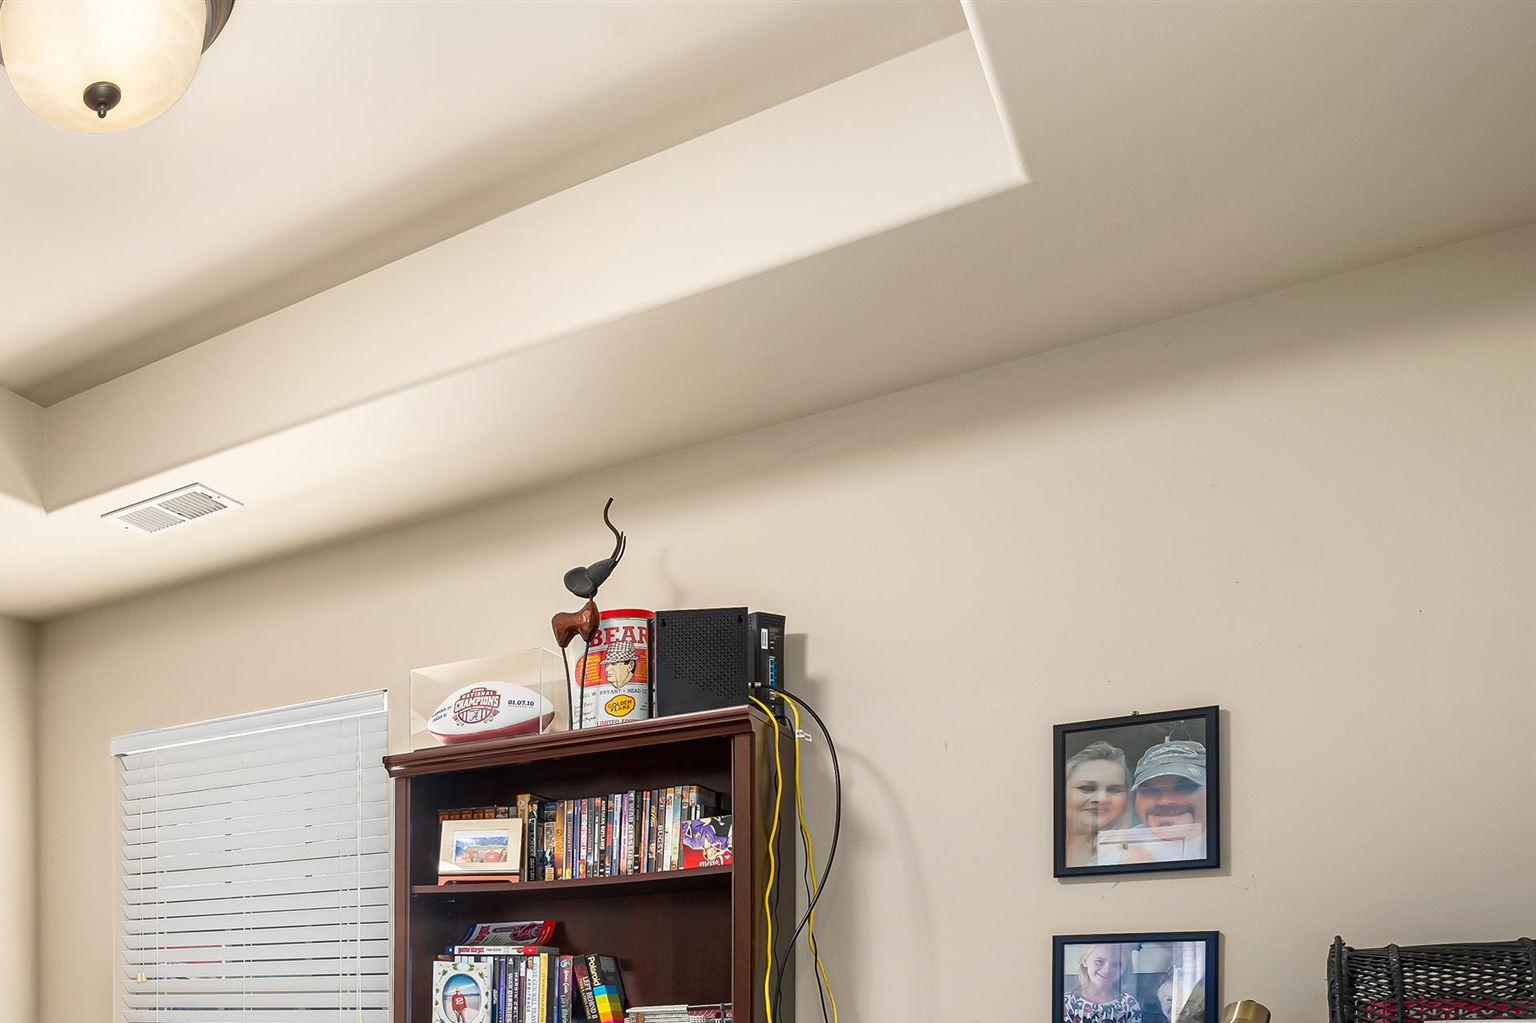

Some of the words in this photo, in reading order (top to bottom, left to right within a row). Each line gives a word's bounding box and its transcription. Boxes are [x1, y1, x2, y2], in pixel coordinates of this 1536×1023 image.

[589, 626, 648, 647] BEAR
[455, 696, 499, 711] CHAMPIONS
[507, 699, 535, 707] 01.07.10
[608, 700, 632, 708] GOLDEN
[611, 705, 631, 714] FLAKE
[587, 956, 601, 986] Polaroid
[583, 976, 591, 990] LEFT
[585, 992, 596, 1014] BEHIND
